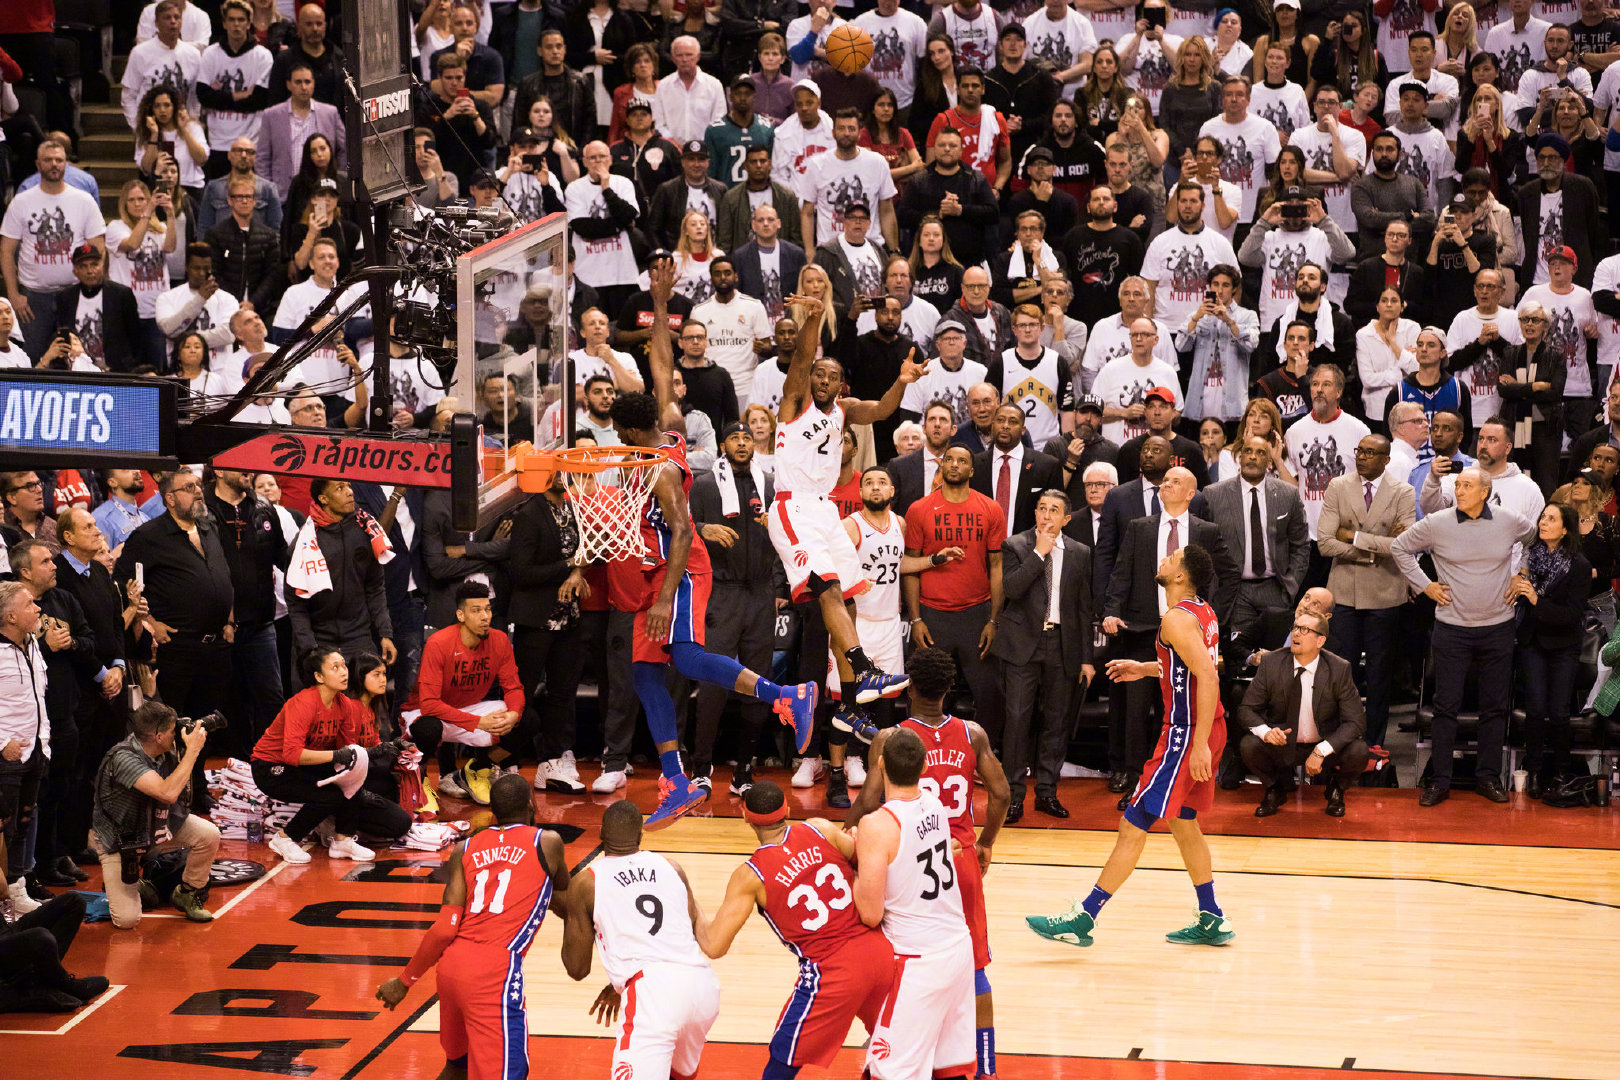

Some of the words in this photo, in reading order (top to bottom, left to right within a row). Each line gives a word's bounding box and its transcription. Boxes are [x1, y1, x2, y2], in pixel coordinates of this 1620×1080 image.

[1090, 11, 1126, 22] NORTH
[1174, 9, 1209, 20] NORTH
[1477, 18, 1499, 30] RTH
[1574, 33, 1588, 43] WE
[1590, 32, 1612, 43] THE
[377, 89, 411, 119] TISSOT
[586, 239, 622, 254] NORTH
[1271, 289, 1294, 300] NOR
[638, 312, 682, 327] Supme
[708, 337, 749, 347] Emirates
[1007, 381, 1054, 404] NORTH
[1470, 386, 1495, 396] NOR
[1, 389, 115, 444] AYOFFS
[1025, 399, 1037, 418] 2
[1123, 428, 1151, 439] NOR
[817, 433, 830, 456] 2
[1304, 489, 1325, 501] NOR
[934, 513, 950, 527] WE
[956, 513, 984, 527] THE
[934, 527, 984, 542] NORTH
[876, 562, 899, 585] 23
[454, 660, 469, 674] WE
[472, 656, 491, 671] THE
[450, 671, 491, 687] NORTH
[926, 749, 966, 769] UTLER
[916, 814, 940, 840] GASOL
[774, 845, 823, 888] HARRIS
[916, 839, 954, 901] 33
[613, 867, 657, 888] IBAKA
[470, 868, 512, 914] 11
[787, 862, 853, 932] 33
[635, 893, 664, 937] 9
